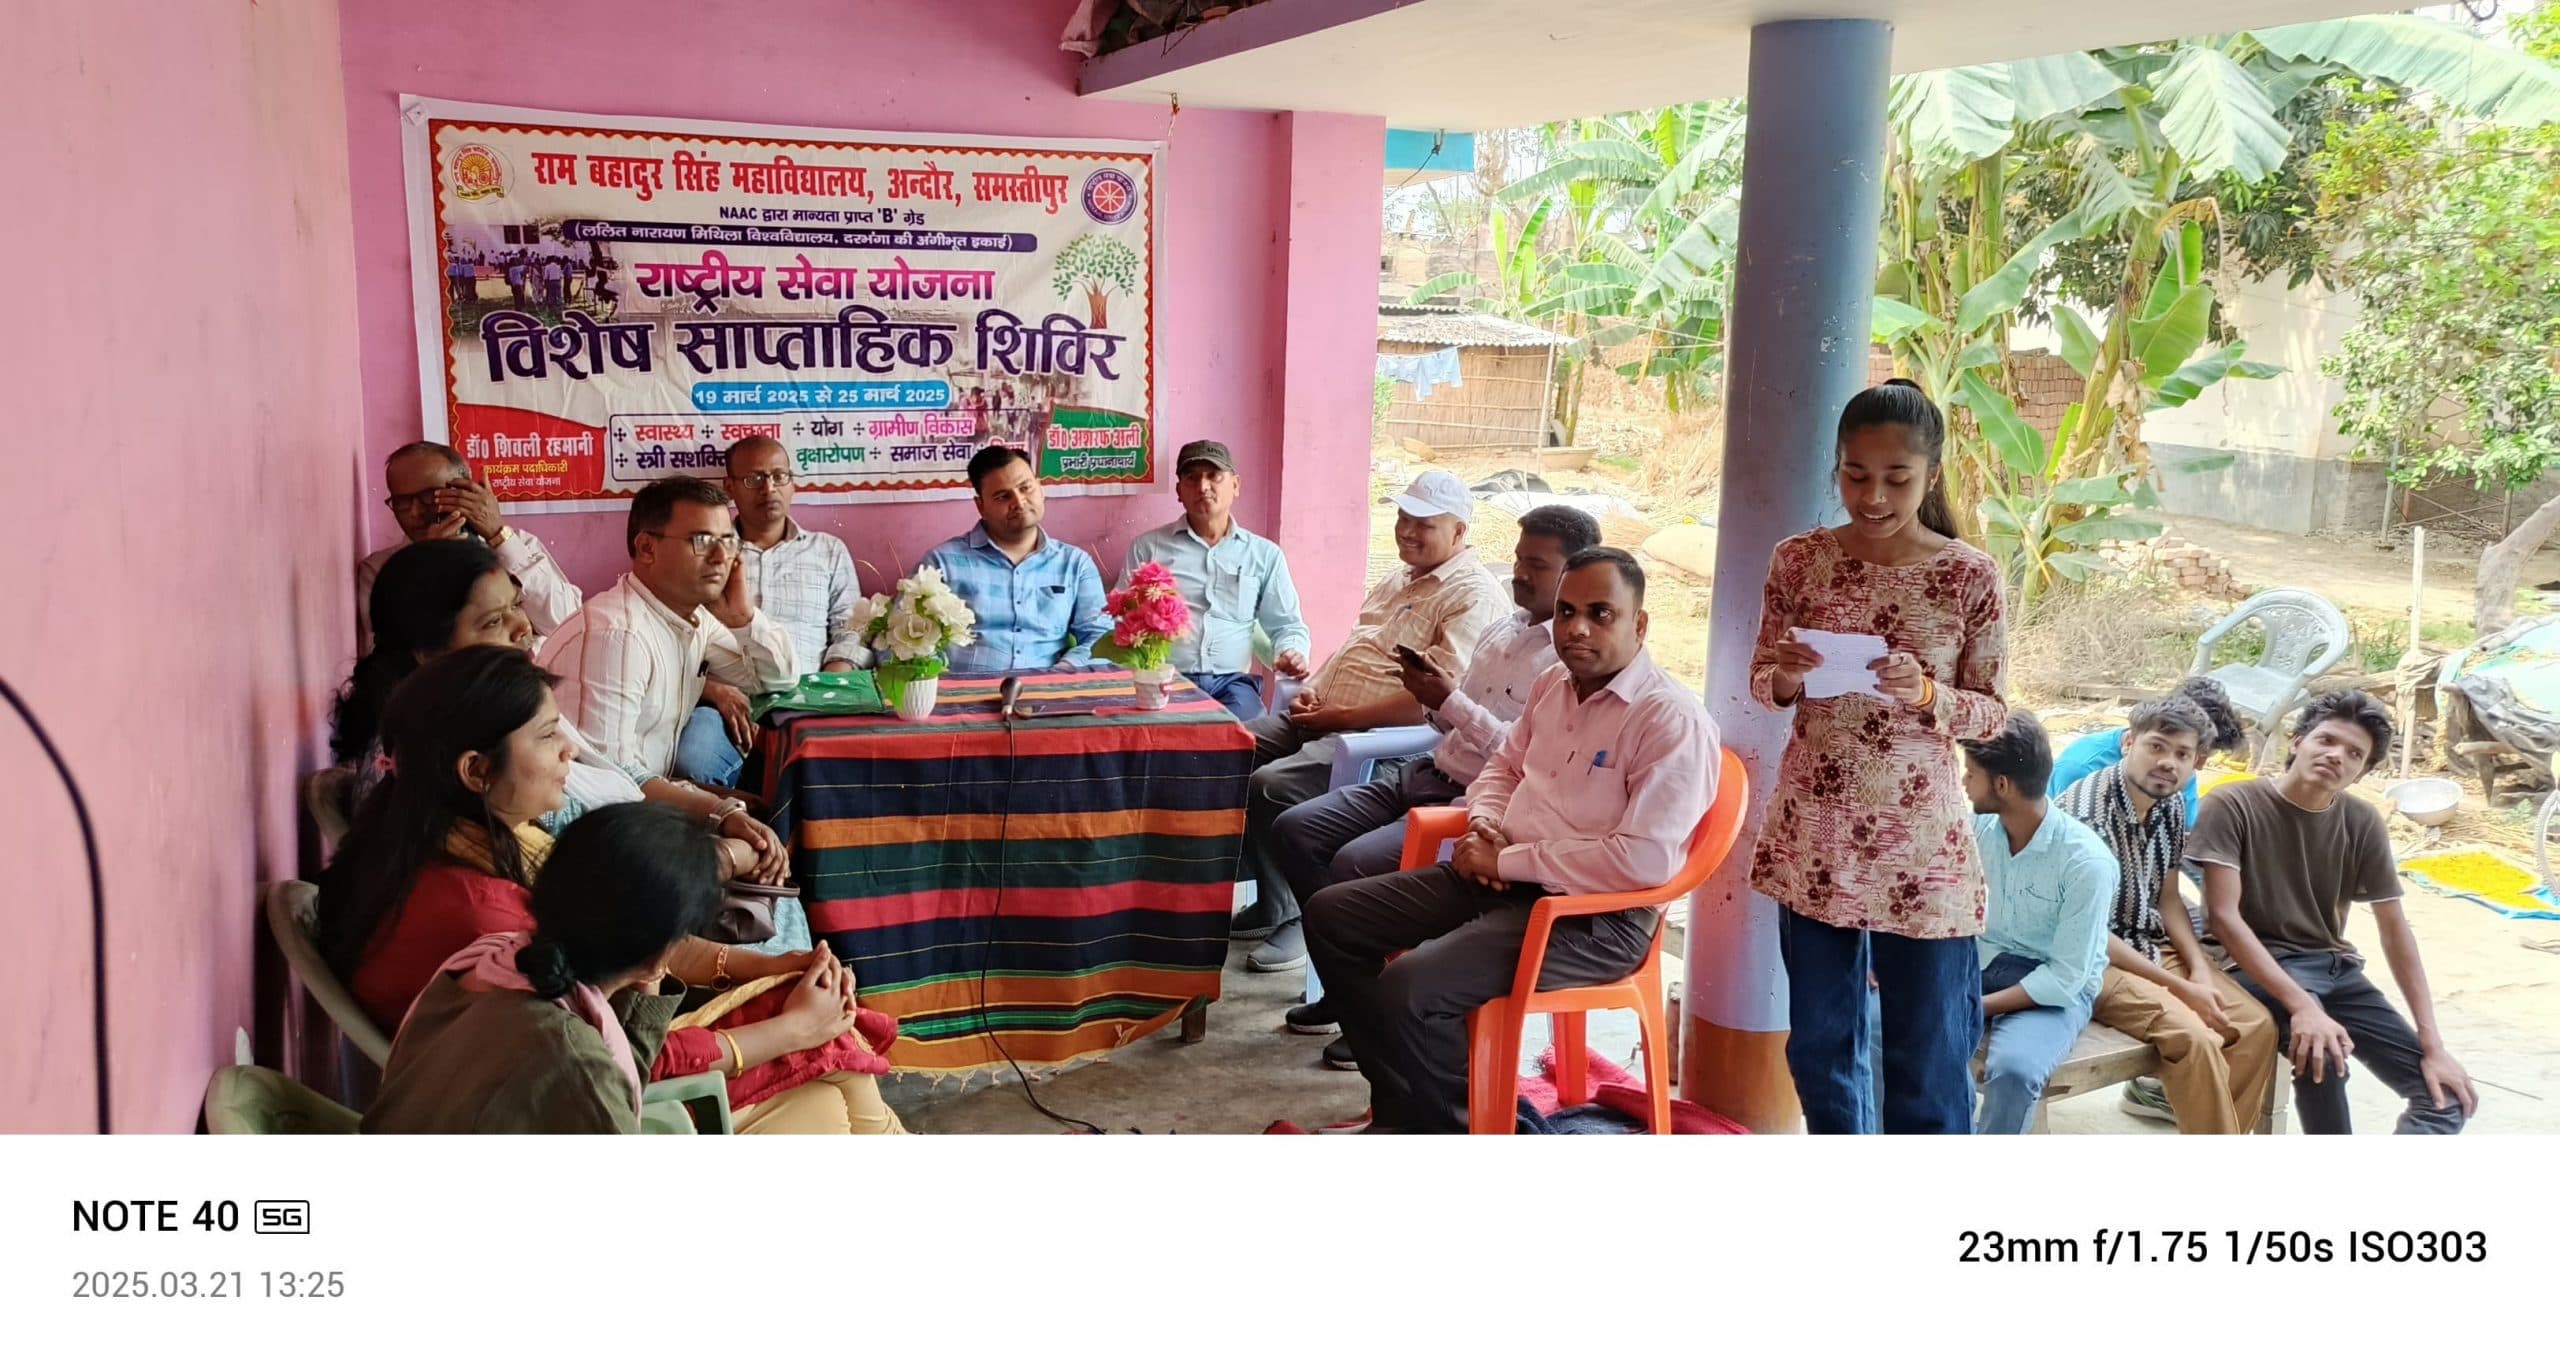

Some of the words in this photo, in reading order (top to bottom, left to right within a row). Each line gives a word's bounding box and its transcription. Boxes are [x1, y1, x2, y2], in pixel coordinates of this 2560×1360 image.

[531, 152, 577, 186] राम
[586, 155, 664, 201] बहादुर
[672, 150, 721, 192] सिंह
[730, 155, 874, 204] महाविद्यालय,
[888, 161, 961, 207] अन्दौर,
[971, 164, 1069, 214] समस्तीपुर
[719, 206, 758, 221] NAAC
[762, 208, 788, 222] द्वारा
[792, 209, 840, 223] मान्यता
[844, 210, 873, 225] प्राप्त
[877, 208, 898, 224] 'B'
[903, 209, 925, 226] ग्रेड
[575, 221, 627, 239] (ललित
[632, 225, 686, 240] नारायण
[691, 225, 742, 242] मिथिला
[843, 230, 890, 246] दरभंगा
[893, 231, 913, 246] की
[916, 232, 967, 250] अंगीभूत
[634, 250, 765, 316] राष्ट्रीय
[776, 253, 858, 301] सेवा
[867, 255, 995, 301] योजना
[480, 309, 656, 383] विशेष
[674, 304, 957, 374] साप्ताहिक
[974, 308, 1127, 381] शिविर
[695, 389, 717, 404] 19
[723, 384, 761, 405] मार्च
[767, 389, 809, 404] 2025
[815, 385, 832, 403] से
[838, 389, 859, 403] 25
[864, 385, 900, 403] मार्च
[905, 388, 945, 402] 2025
[634, 424, 695, 442] स्वास्थ्य
[720, 423, 781, 441] स्वच्छता
[810, 415, 844, 437] योग
[868, 413, 919, 440] ग्रामीण
[925, 411, 975, 436] विकास
[493, 432, 541, 458] शिवली
[545, 431, 594, 457] रहमानी
[635, 444, 666, 469] स्त्री
[796, 444, 865, 470] वृक्षारोपण
[890, 445, 937, 462] समाज
[942, 440, 972, 461] सेवा
